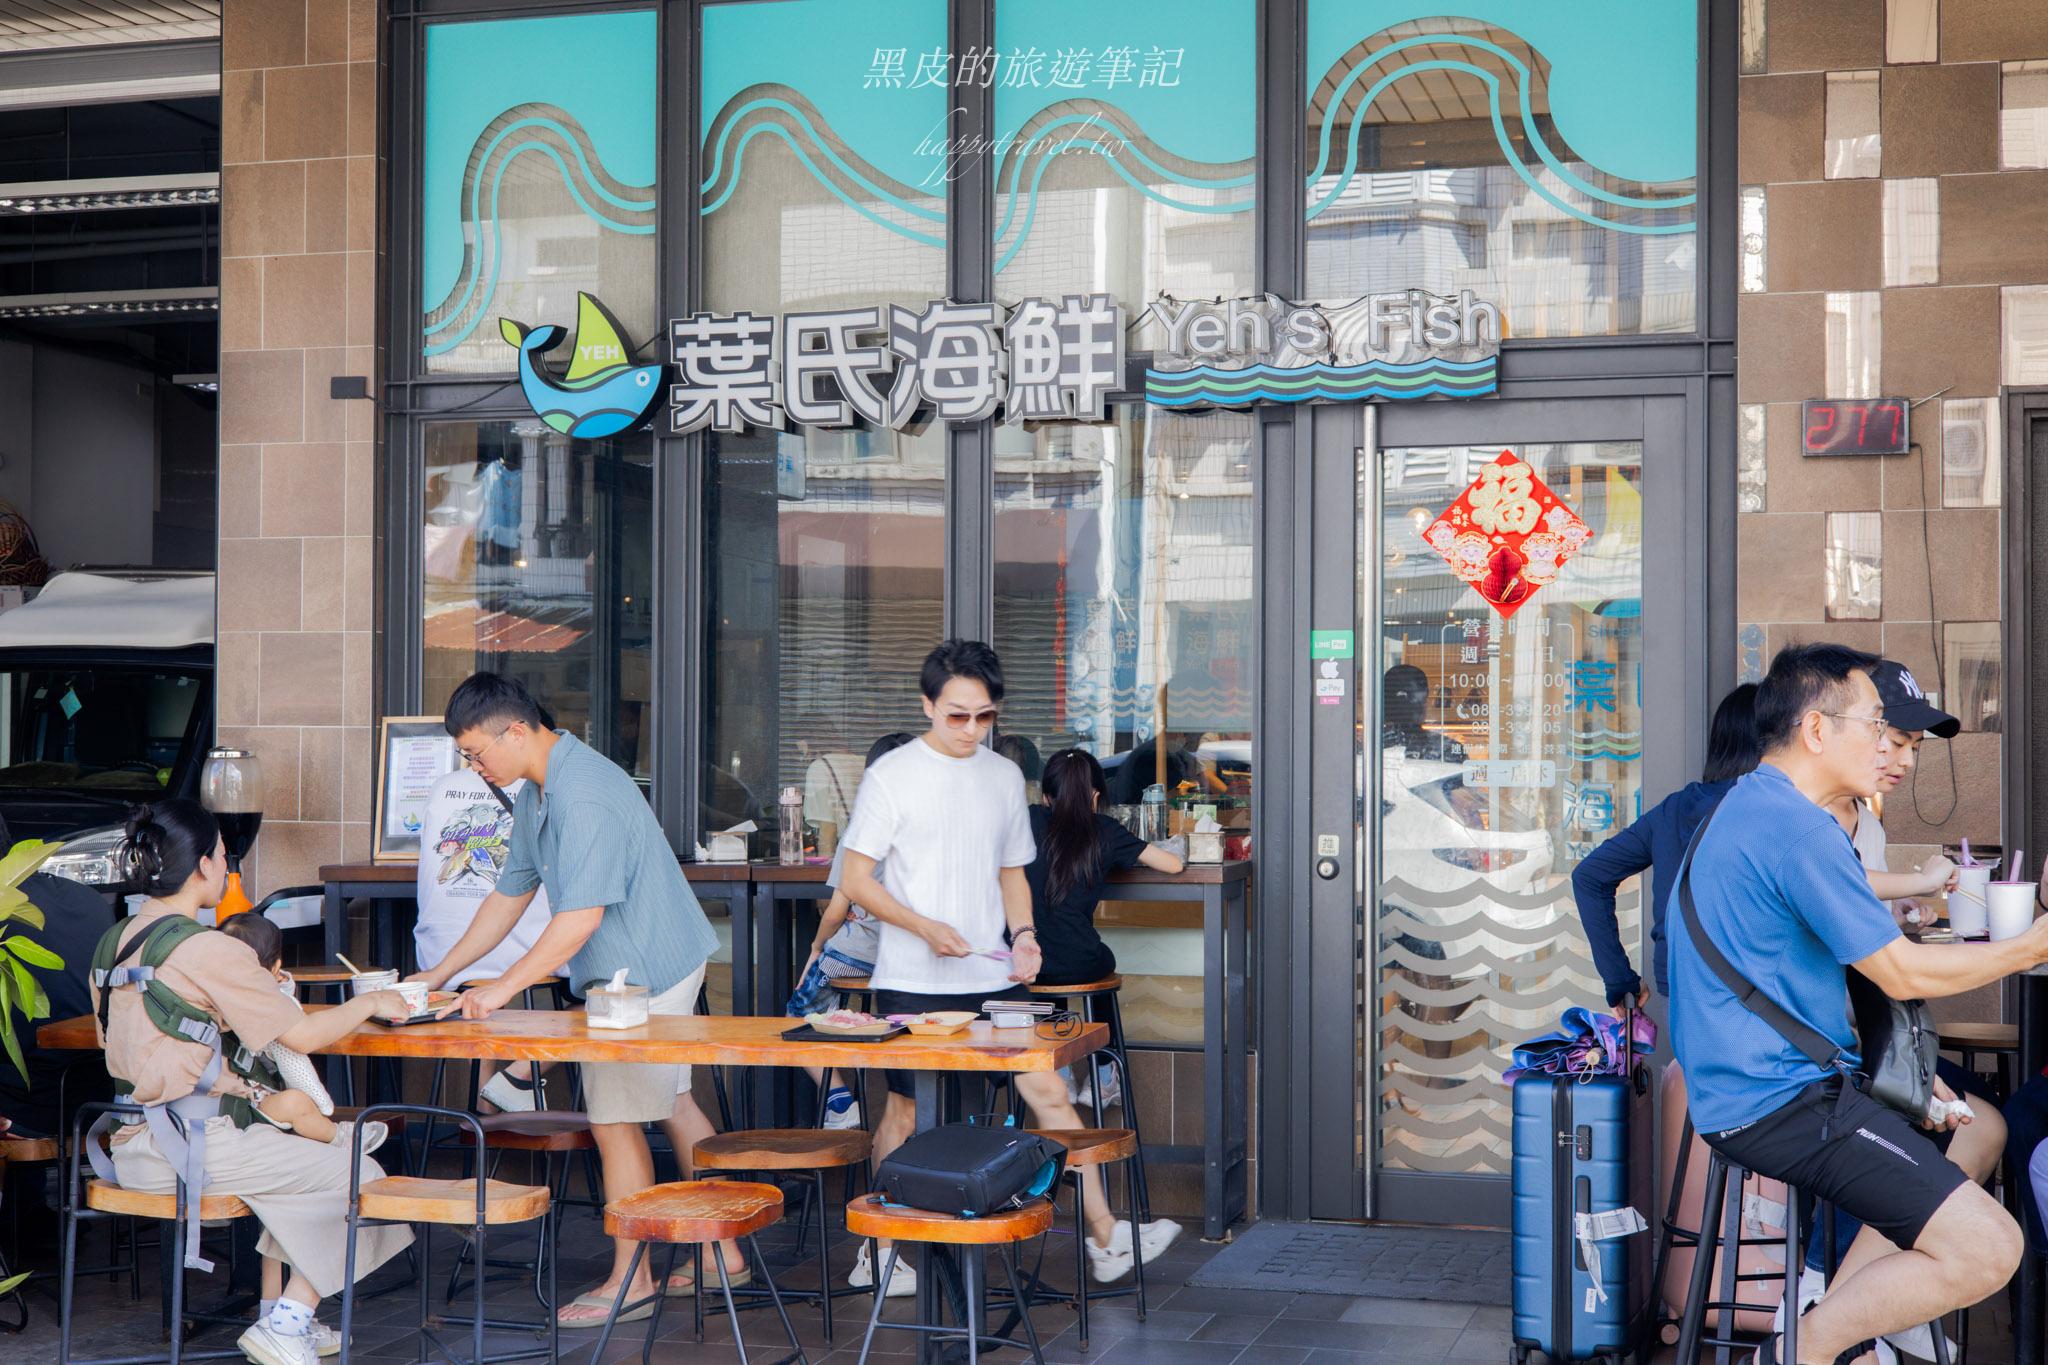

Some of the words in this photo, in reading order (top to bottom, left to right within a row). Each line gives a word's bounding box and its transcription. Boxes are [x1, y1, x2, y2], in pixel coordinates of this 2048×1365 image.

[1150, 291, 1330, 354] Yeh's
[1367, 289, 1499, 350] Fish
[579, 344, 620, 361] YEH
[670, 293, 1127, 433] 葉氏海鮮
[1806, 404, 1901, 449] 277
[1467, 462, 1543, 536] 福
[445, 790, 468, 800] PRAY
[468, 791, 486, 801] FOR
[1856, 1127, 1877, 1143] RUN
